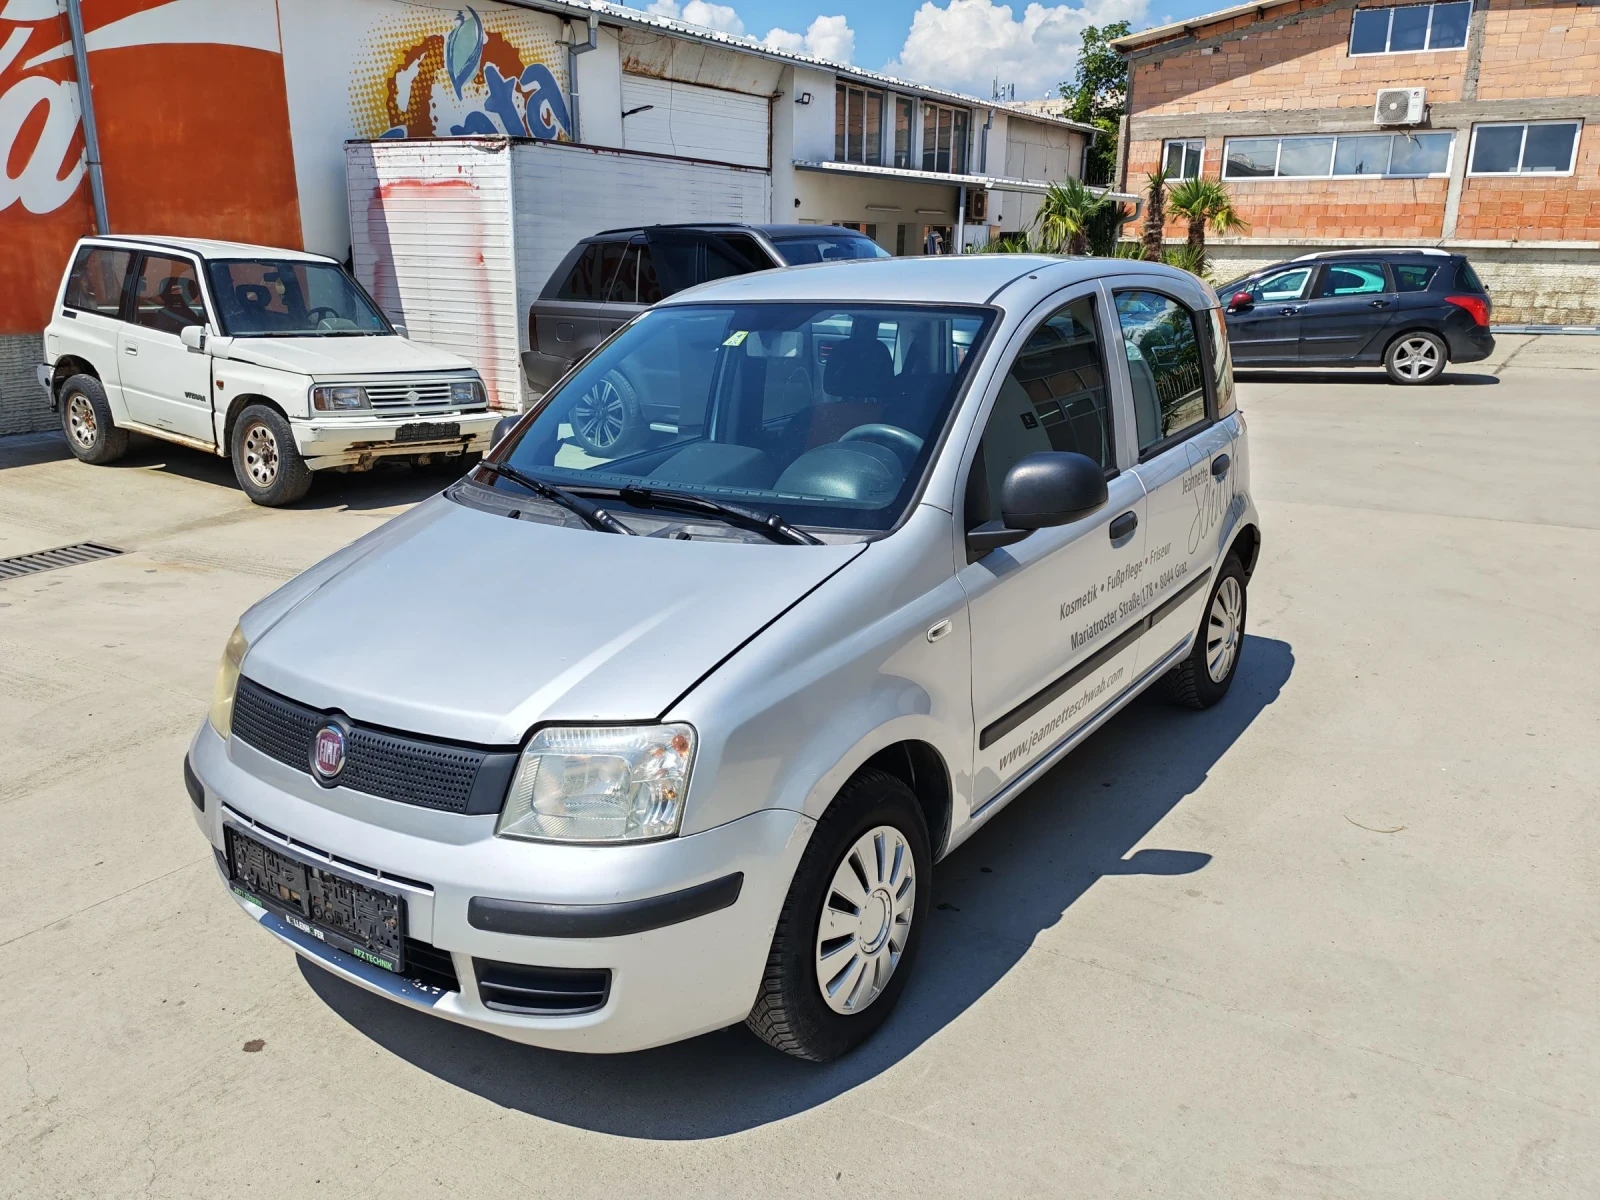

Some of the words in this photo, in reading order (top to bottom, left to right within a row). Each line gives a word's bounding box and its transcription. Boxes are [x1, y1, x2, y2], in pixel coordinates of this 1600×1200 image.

[1182, 467, 1209, 495] Jeannette
[1060, 584, 1098, 621] Kosmetik
[1107, 560, 1143, 592] Fußpflege
[1150, 542, 1171, 565] Friseur
[1070, 609, 1118, 651] Mariatroster
[1118, 593, 1141, 619] Straße
[1141, 582, 1154, 603] 178
[1159, 568, 1174, 590] 8044
[1174, 561, 1188, 579] Graz
[999, 667, 1124, 771] www.jeannetteschwab.com
[319, 739, 340, 765] FIAT
[353, 947, 366, 959] KFZ
[365, 952, 393, 971] TECHNIK
